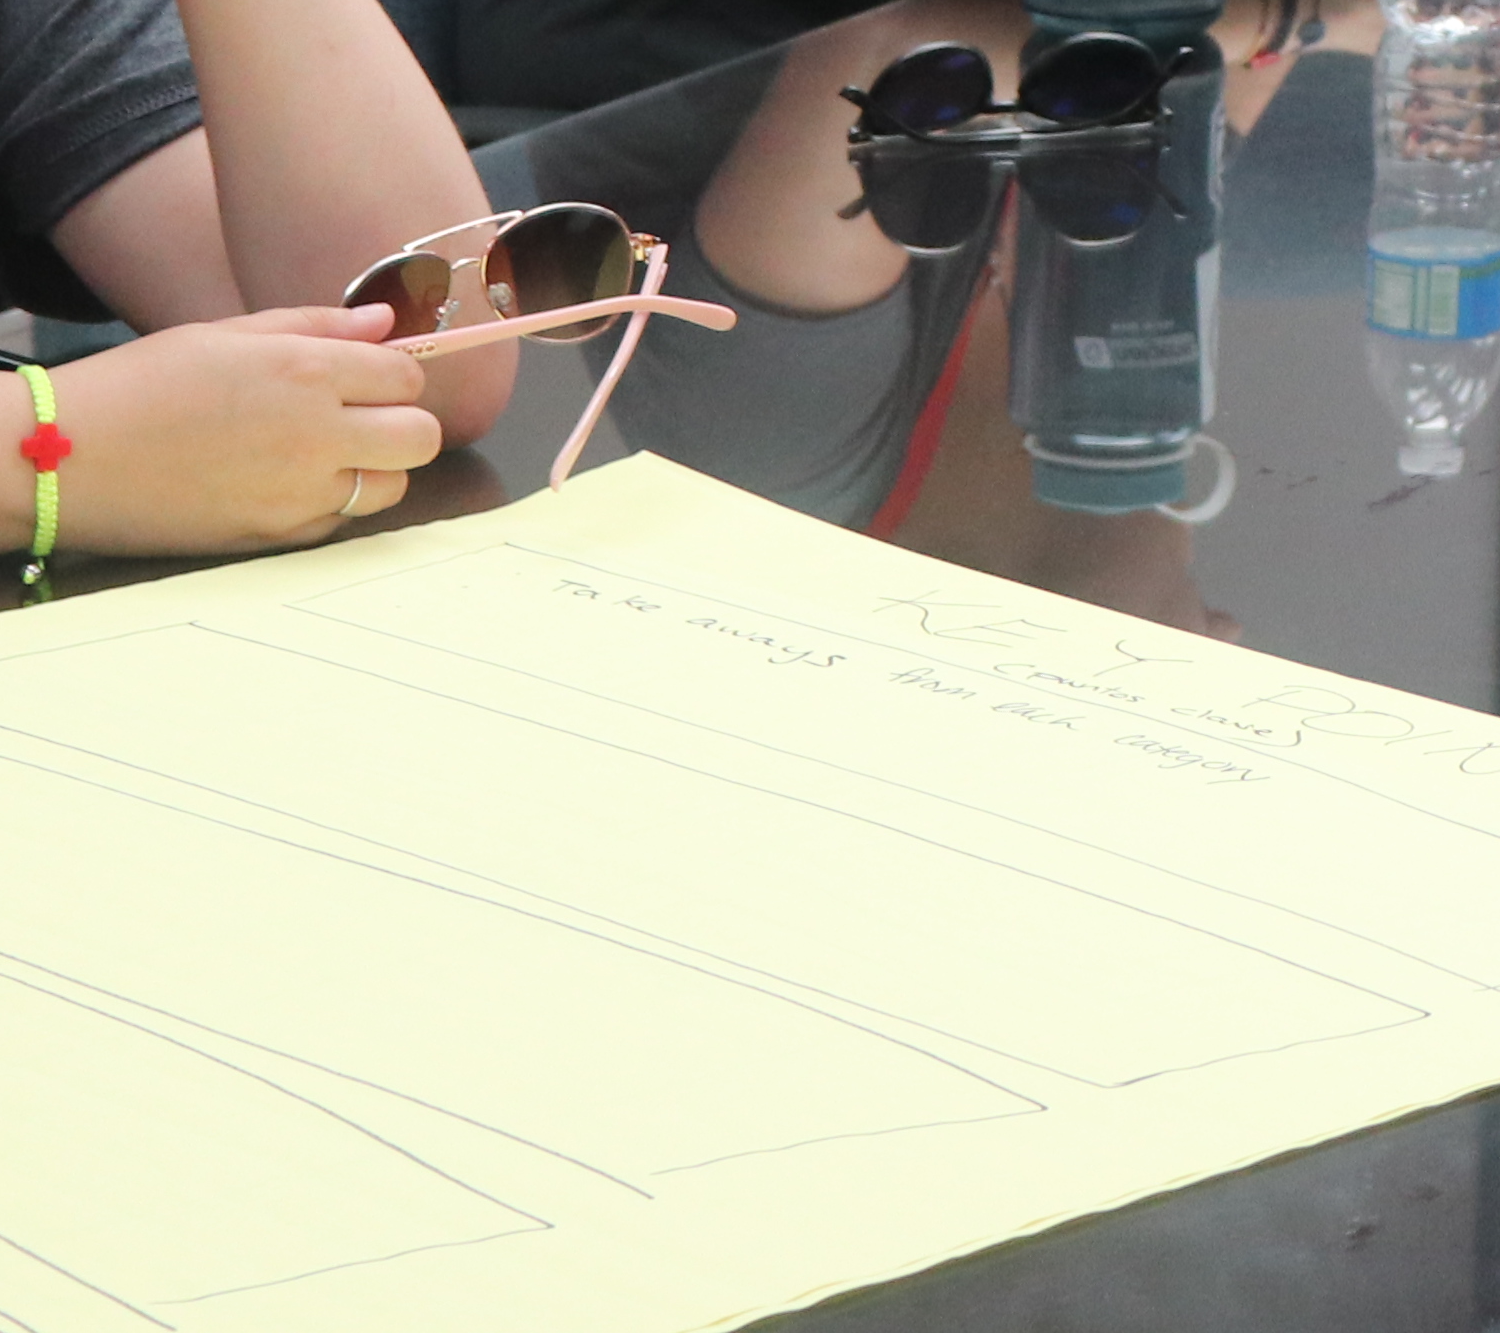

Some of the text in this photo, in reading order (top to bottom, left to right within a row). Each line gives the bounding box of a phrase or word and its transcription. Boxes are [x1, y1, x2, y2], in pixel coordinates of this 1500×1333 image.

[873, 589, 1194, 677] KEY
[685, 617, 847, 668] aways
[889, 667, 977, 700] from
[990, 702, 1087, 732] each
[1113, 734, 1271, 785] category
